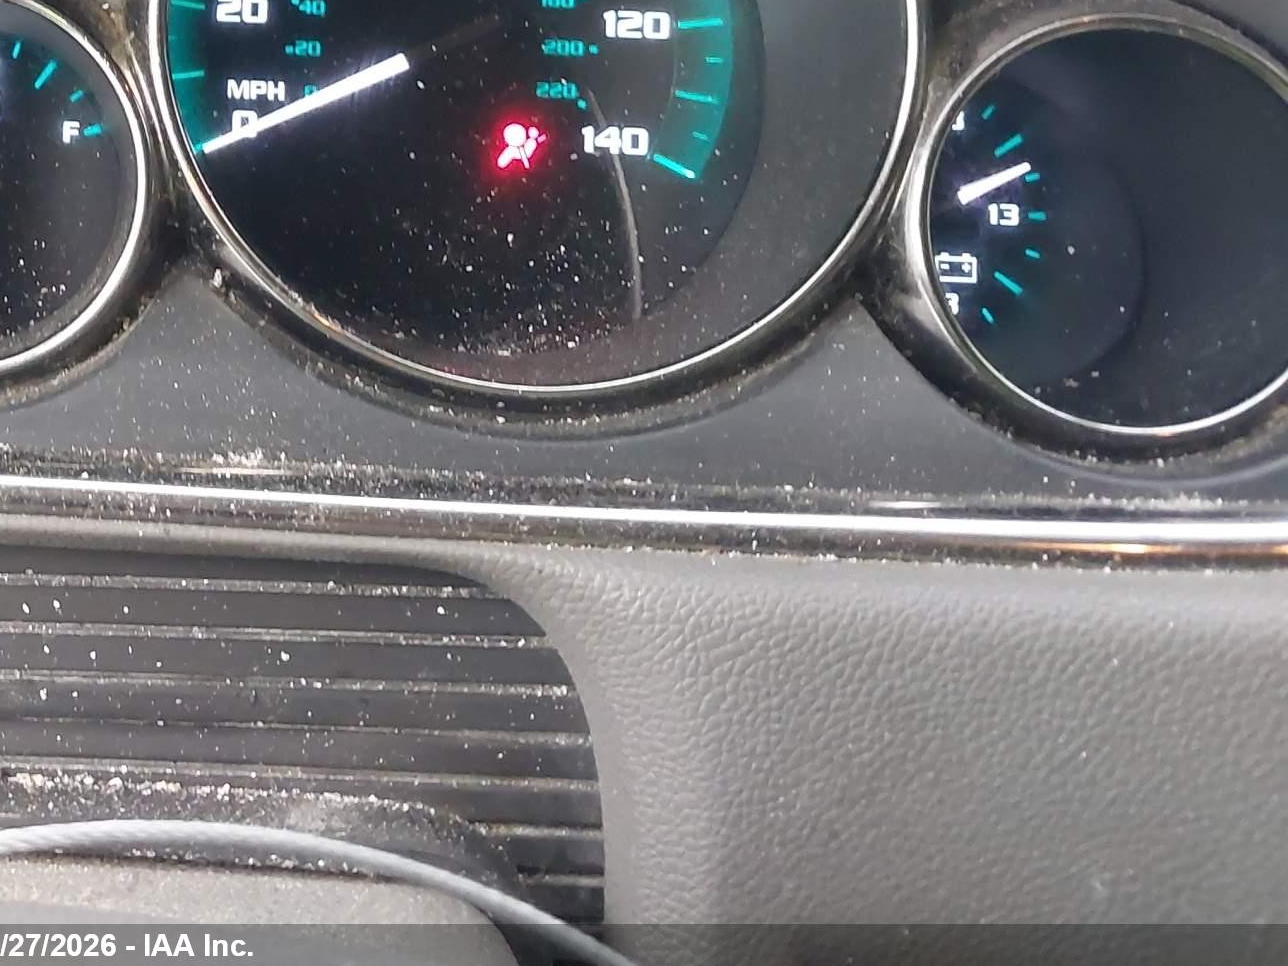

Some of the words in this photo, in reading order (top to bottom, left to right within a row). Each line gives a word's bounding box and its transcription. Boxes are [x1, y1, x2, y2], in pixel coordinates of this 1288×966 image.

[603, 10, 672, 40] 120
[294, 39, 322, 57] 20
[541, 39, 585, 56] 200
[227, 79, 286, 102] MPH
[535, 82, 578, 99] 220
[62, 120, 81, 144] F
[582, 126, 650, 157] 140
[987, 203, 1020, 227] 13
